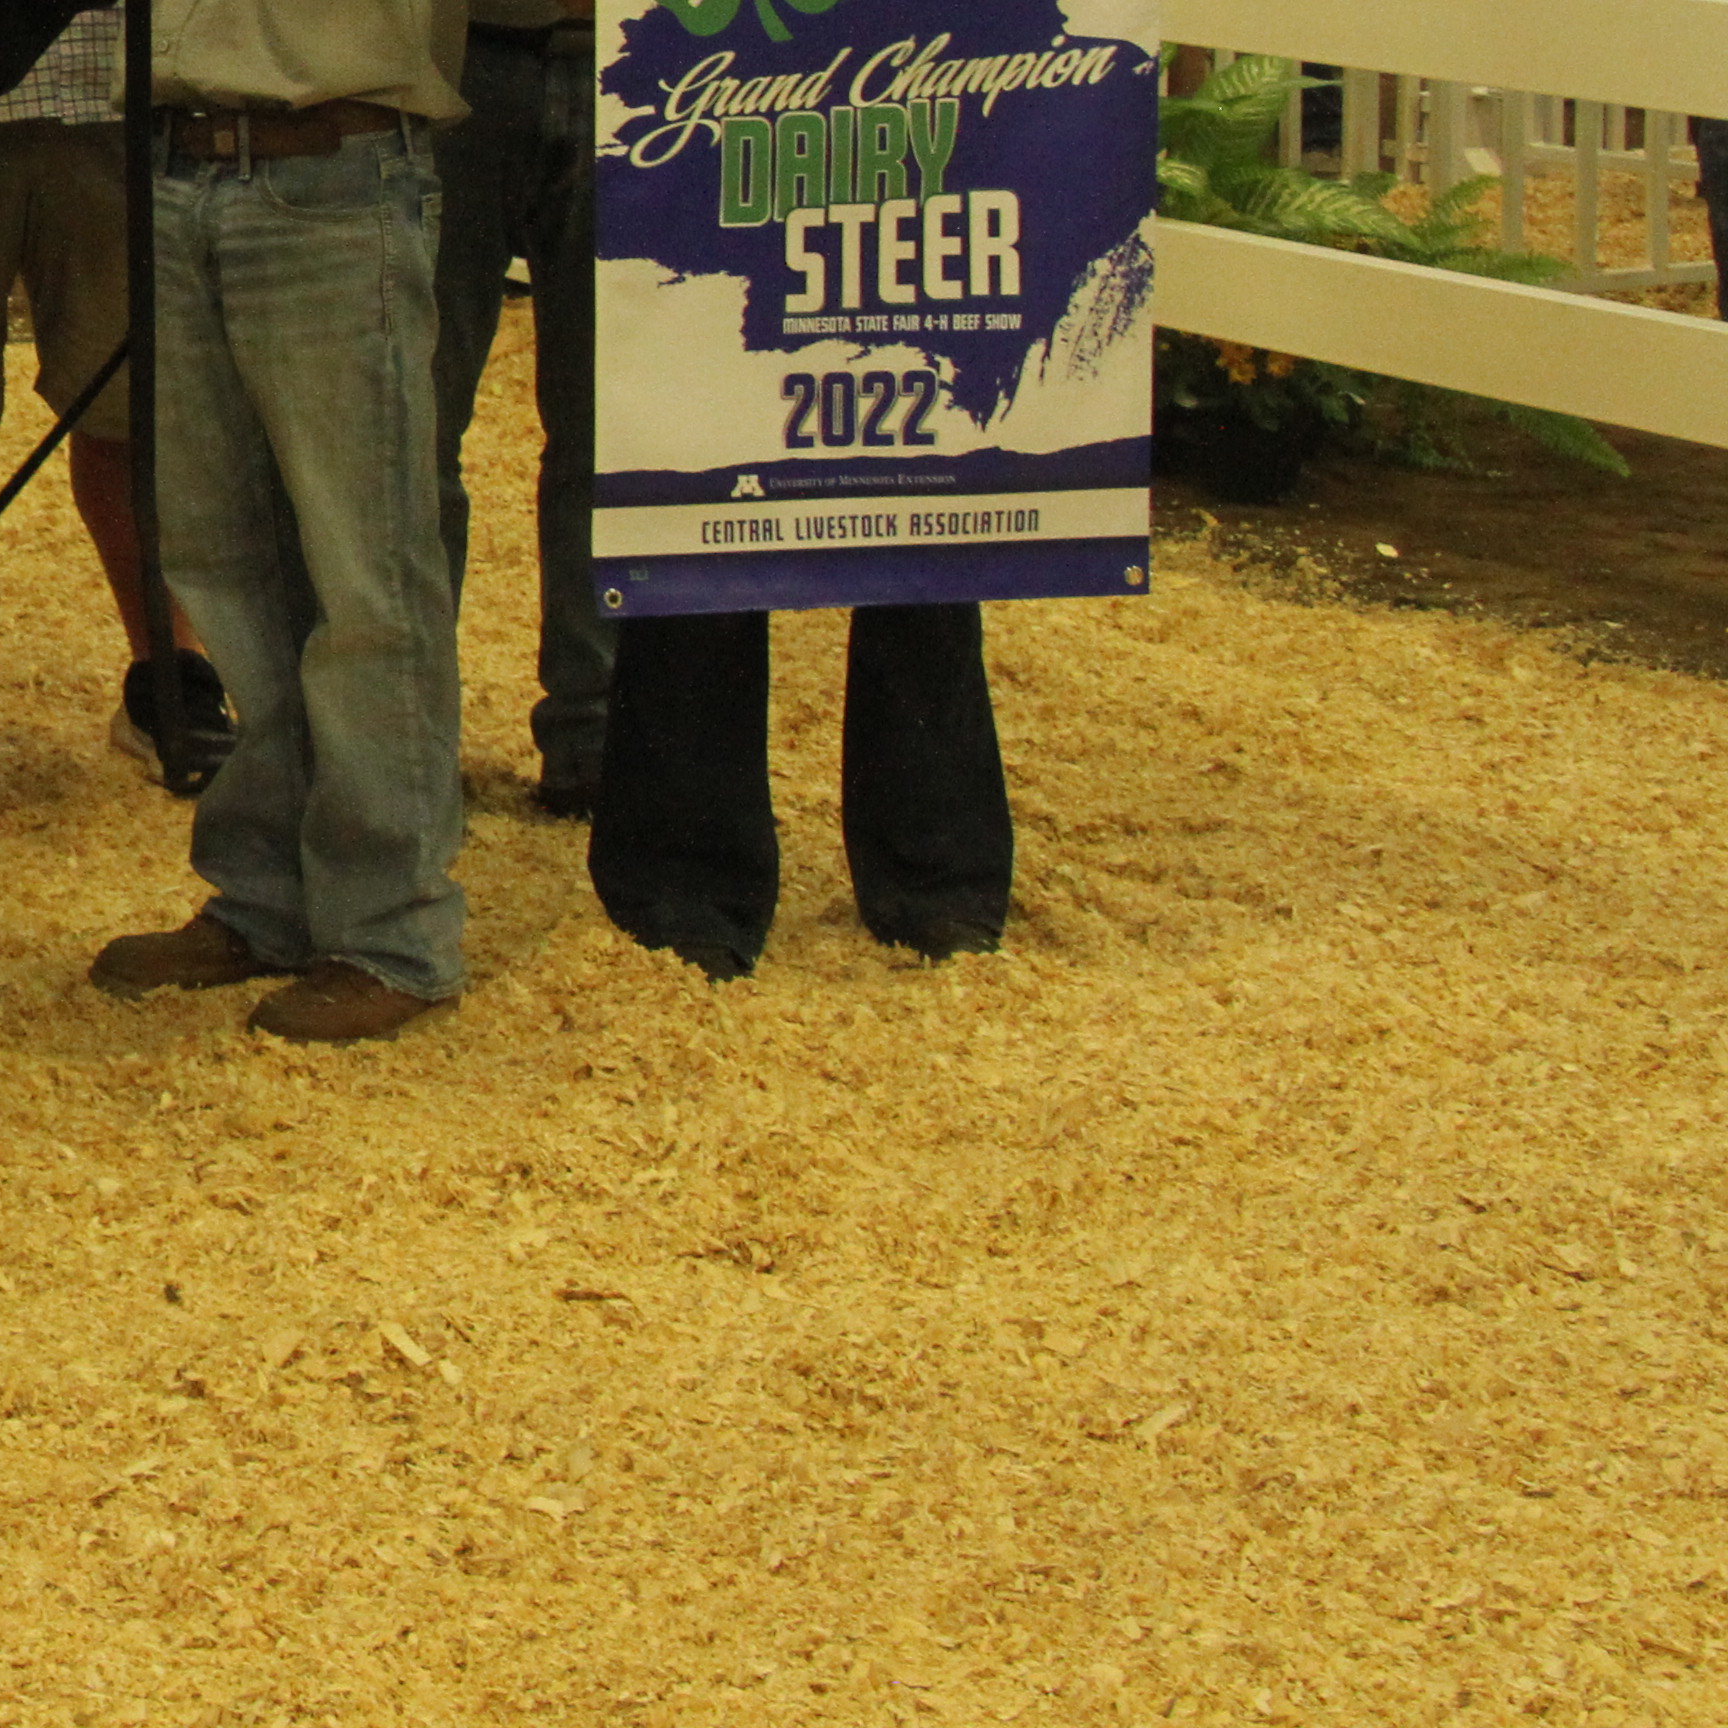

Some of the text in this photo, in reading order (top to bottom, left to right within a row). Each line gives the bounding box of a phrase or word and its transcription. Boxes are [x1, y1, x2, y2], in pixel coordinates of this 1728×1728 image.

[629, 32, 1117, 168] Grand Champion
[719, 98, 960, 228] DAIRY
[783, 190, 1021, 313] STEER
[783, 313, 1022, 334] MINNESOTA STATE FAIR 4-H BEEF SHOW
[781, 370, 940, 451] 2022
[701, 508, 1040, 545] CENTRAL LIVESTOCK ASSOCIATION
